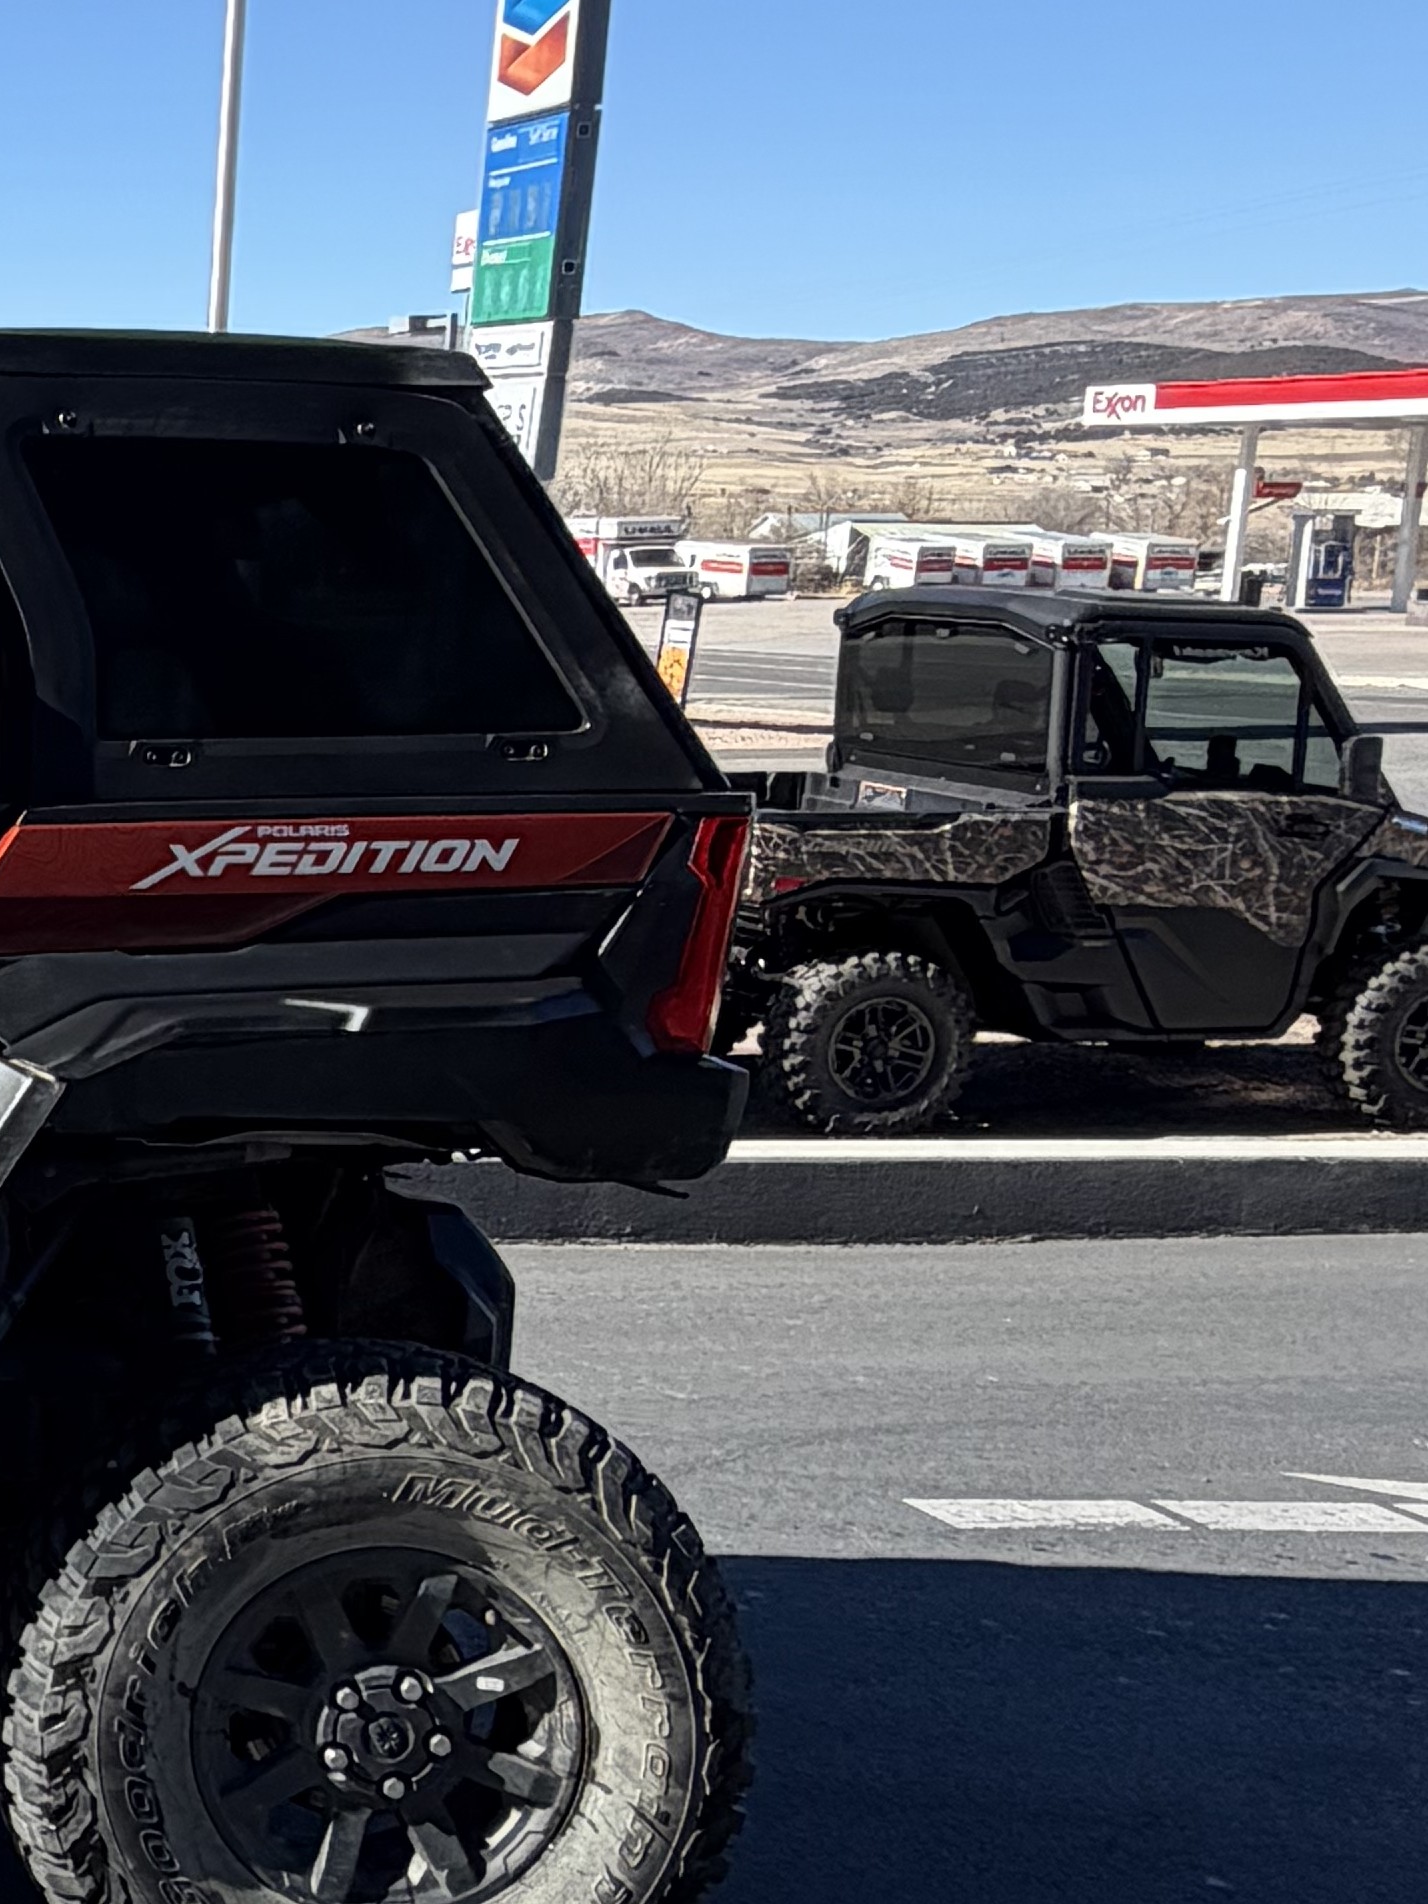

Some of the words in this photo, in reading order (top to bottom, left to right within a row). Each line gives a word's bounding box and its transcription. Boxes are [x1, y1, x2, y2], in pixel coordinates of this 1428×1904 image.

[1092, 391, 1147, 420] Exxon
[257, 824, 350, 838] POLARIS
[129, 826, 520, 890] XPEDITION
[161, 1231, 204, 1307] FOX
